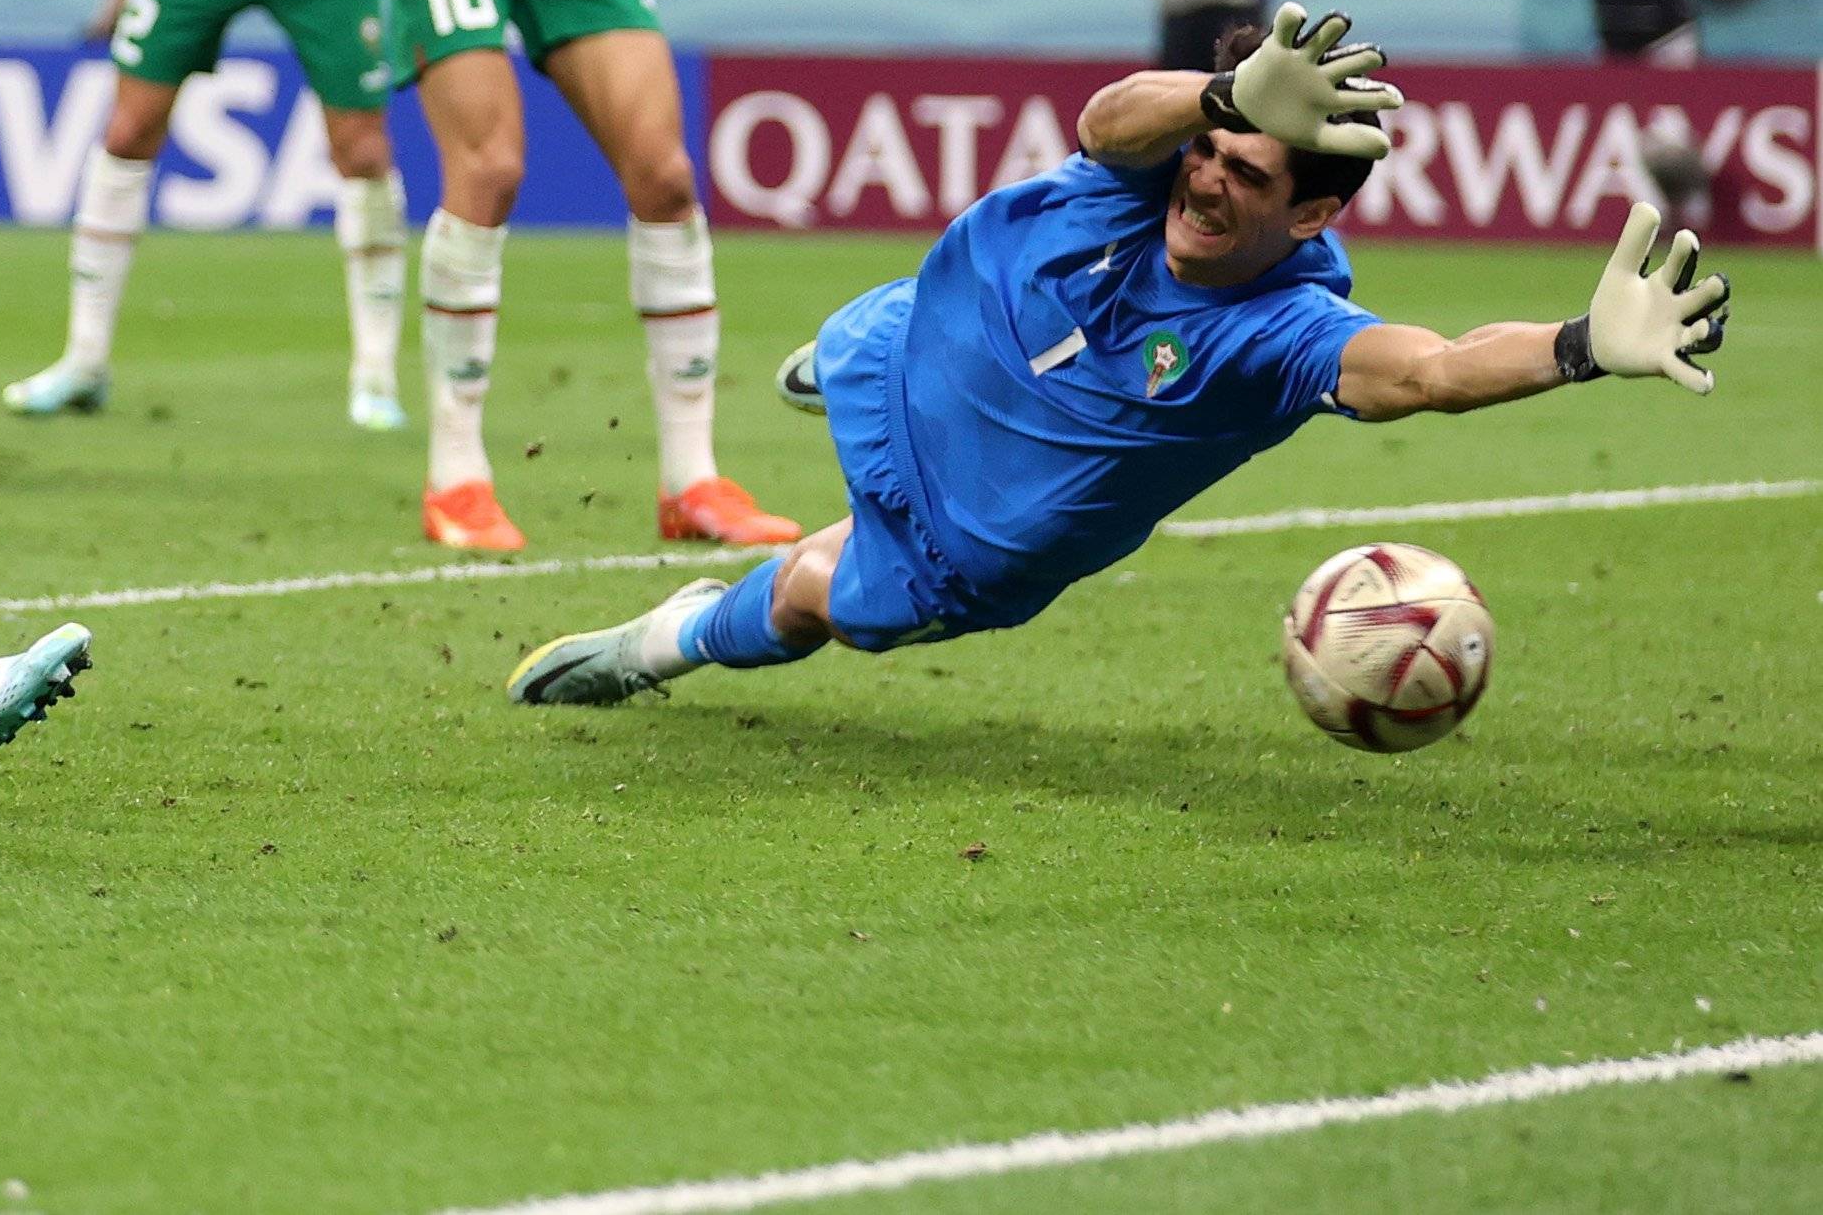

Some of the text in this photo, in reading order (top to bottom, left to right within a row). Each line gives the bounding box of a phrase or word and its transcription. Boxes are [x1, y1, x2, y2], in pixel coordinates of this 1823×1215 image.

[708, 89, 1815, 232] QATA RWAYS
[1028, 325, 1088, 378] 1
